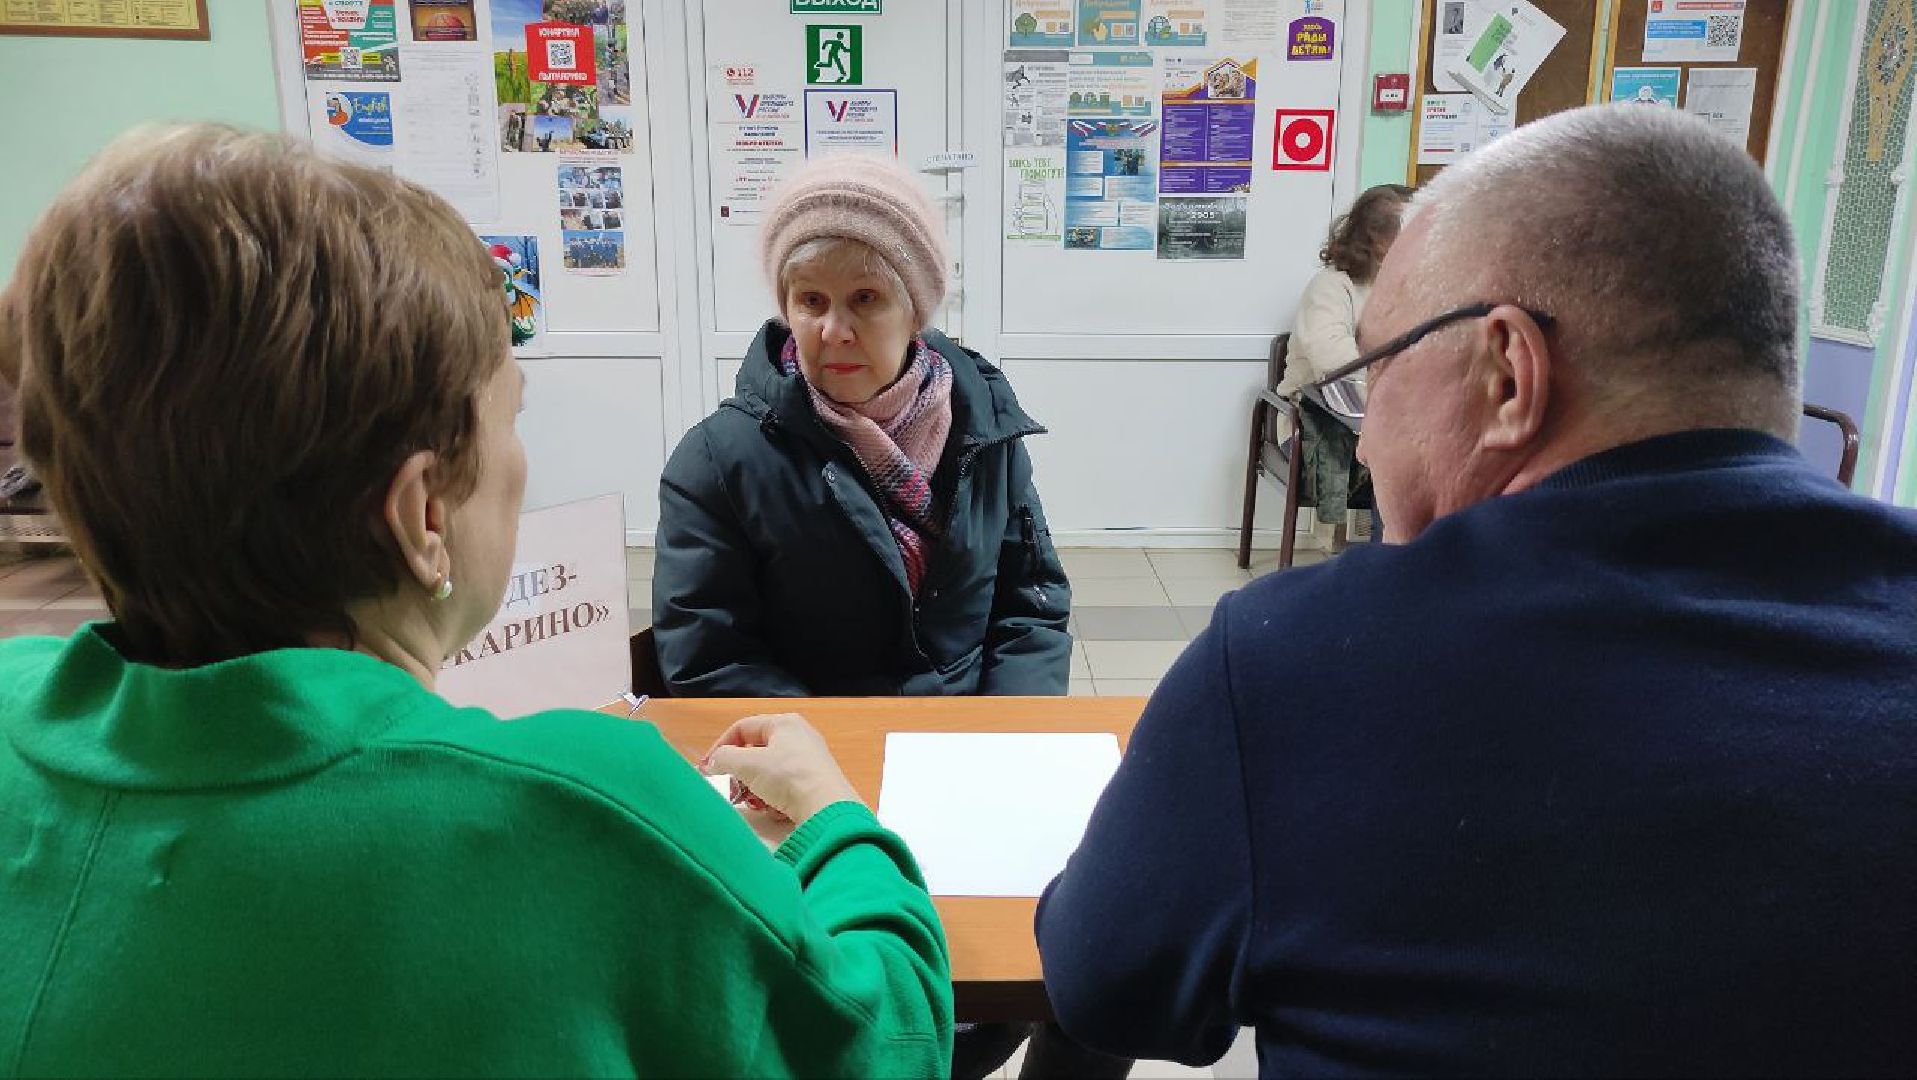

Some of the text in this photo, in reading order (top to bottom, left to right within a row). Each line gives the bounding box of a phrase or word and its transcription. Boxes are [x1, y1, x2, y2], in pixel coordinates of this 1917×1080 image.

[1296, 32, 1327, 43] РАДЫ
[1291, 44, 1331, 56] ДЕТЯМ!
[738, 67, 754, 77] 112
[353, 96, 388, 116] English
[506, 563, 578, 610] ДЕЗ-
[441, 601, 610, 670] КАРИНО»
